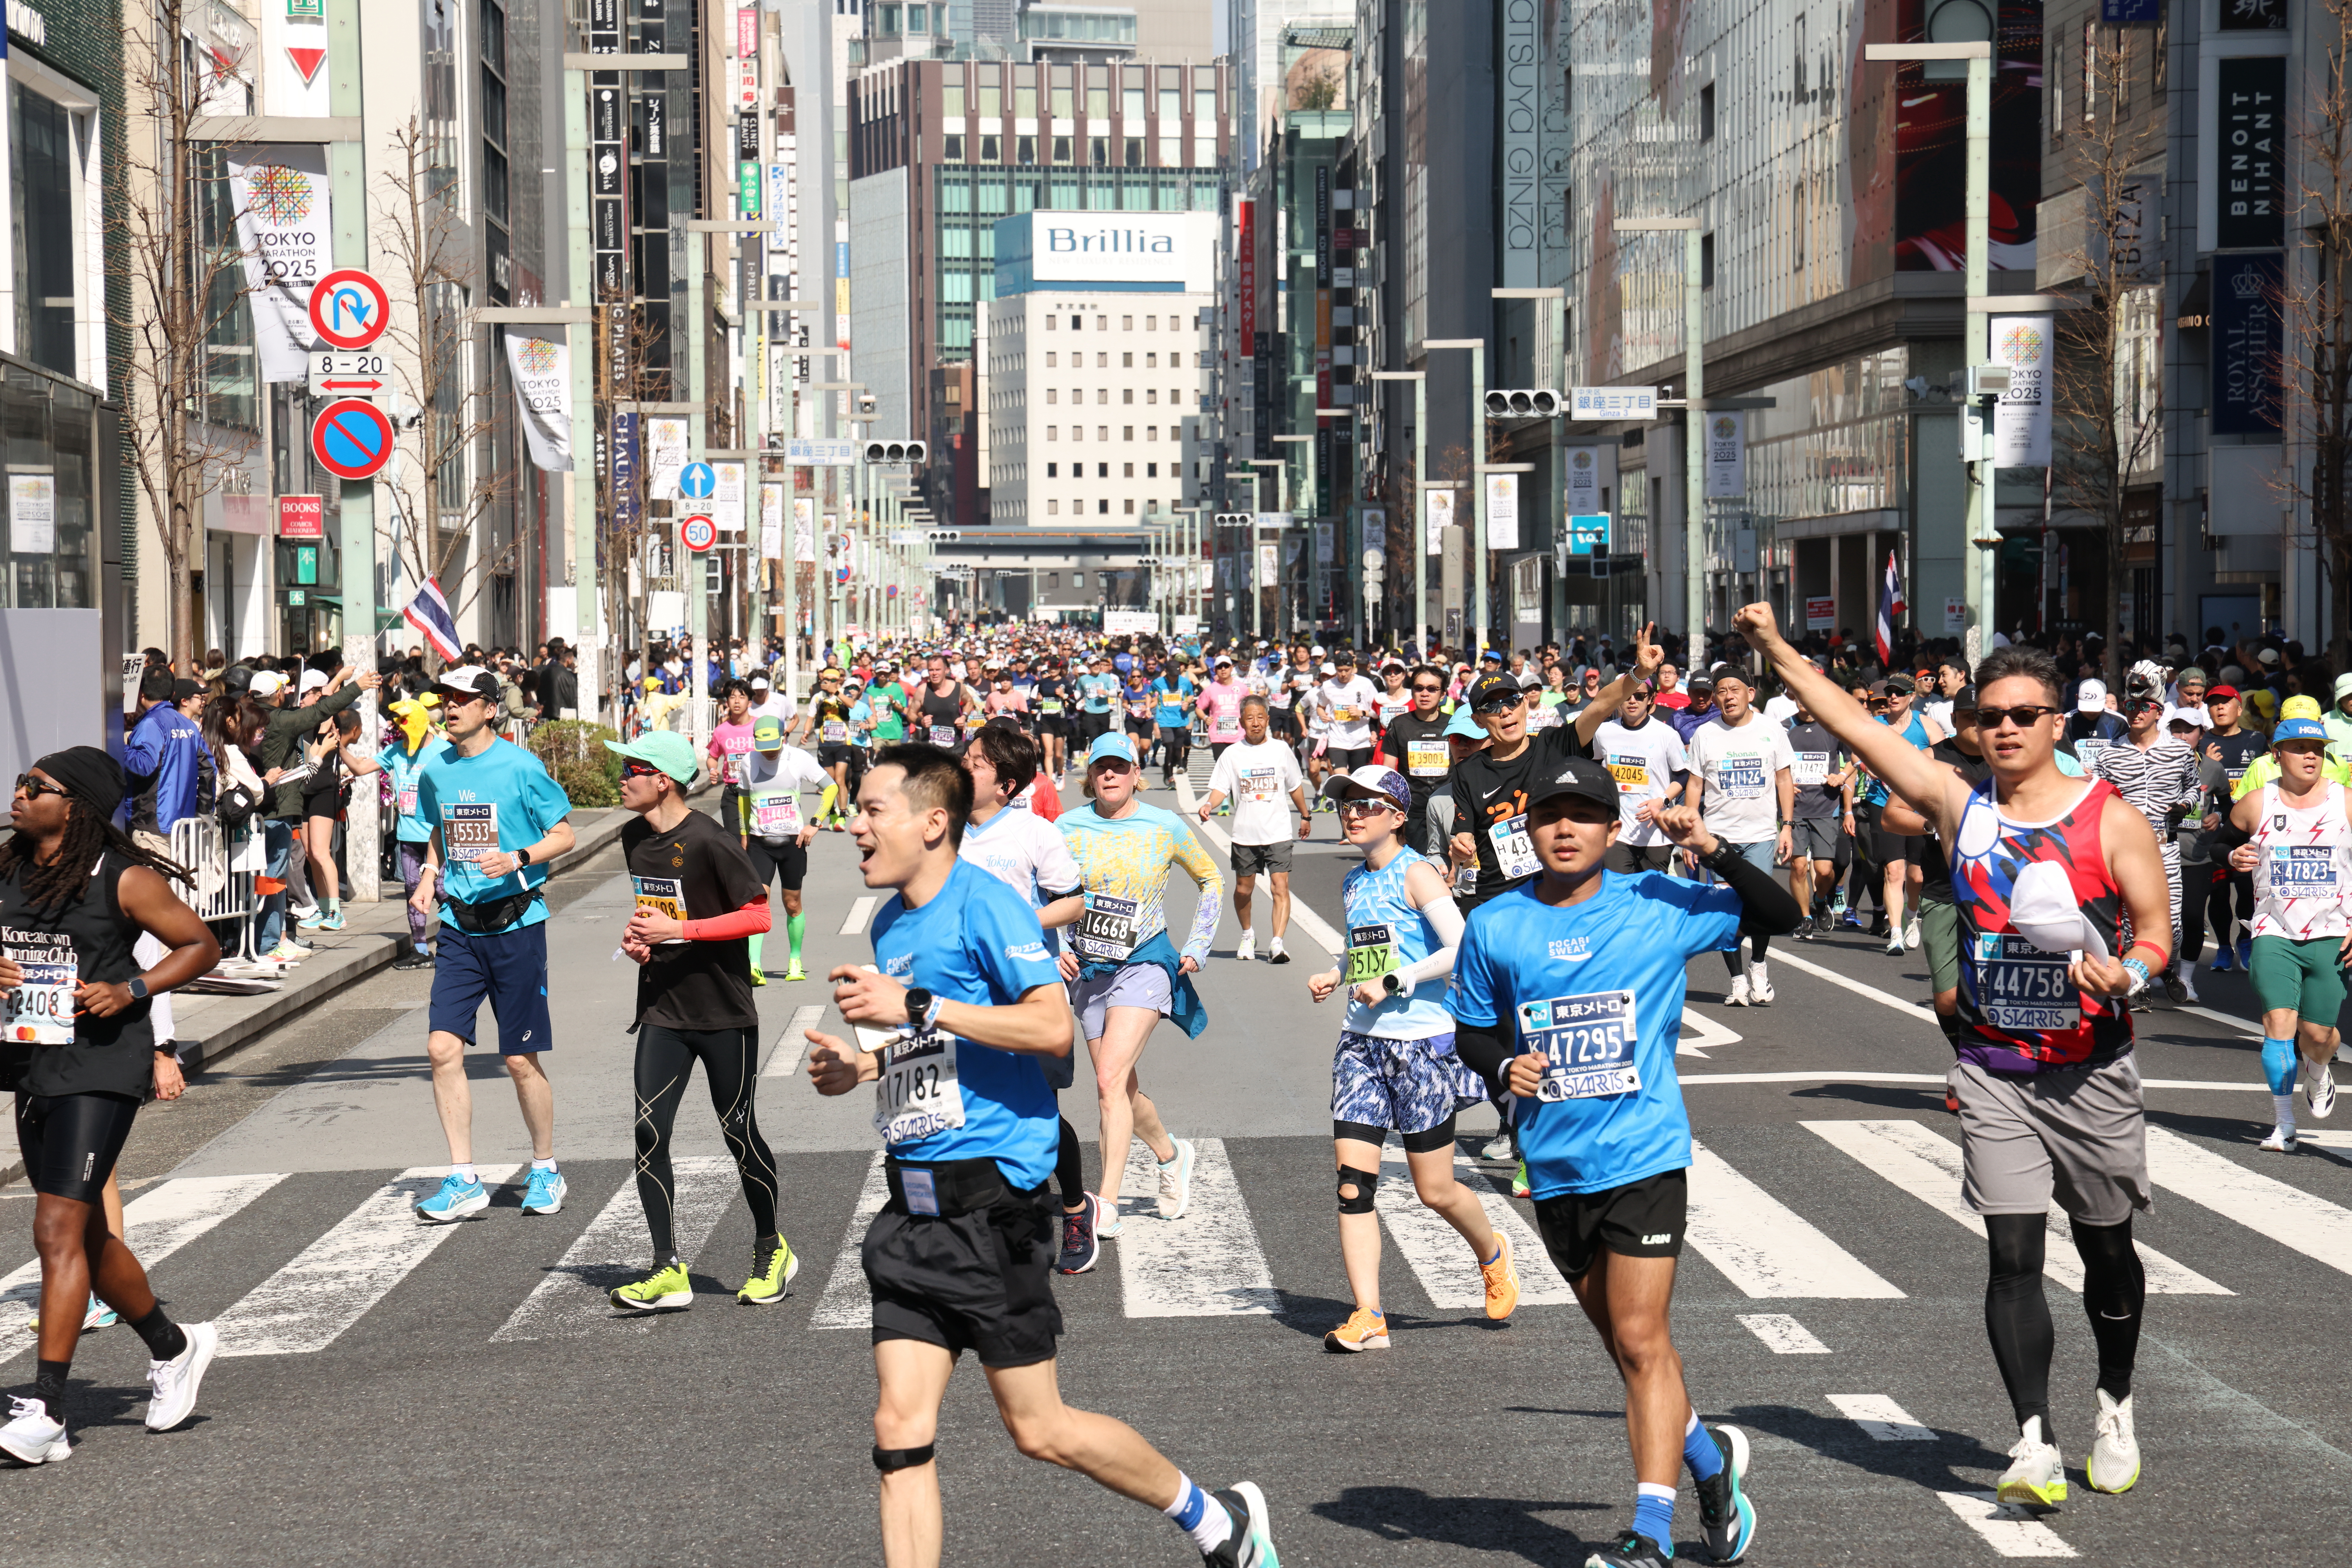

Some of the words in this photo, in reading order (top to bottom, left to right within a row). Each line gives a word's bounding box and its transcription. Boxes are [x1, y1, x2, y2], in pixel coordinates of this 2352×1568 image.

[649, 99, 660, 153] ジェーン英会話
[2231, 93, 2248, 215] BENOIT
[2254, 92, 2271, 214] NIHANT
[254, 232, 315, 246] TOKYO
[1047, 229, 1174, 253] Brillia
[259, 249, 315, 257] MARATHON
[262, 260, 316, 278] 2025
[1242, 262, 1252, 332] 銀座アスター
[2227, 321, 2246, 403] ROYAL
[2249, 305, 2267, 415] ASSCHER
[521, 379, 560, 389] TOKYO
[526, 396, 561, 408] 2025
[1578, 396, 1651, 409] 銀座三丁目
[790, 446, 850, 457] 銀座三丁目
[283, 503, 320, 513] BOOKS
[689, 526, 708, 541] 50
[1218, 694, 1238, 704] HMJ
[2299, 726, 2324, 737] HOKA
[1418, 753, 1443, 764] 39003
[1615, 767, 1642, 781] 42045
[1800, 763, 1824, 773] 17472
[1249, 779, 1274, 789] 34498
[1730, 771, 1760, 784] 41126
[458, 789, 475, 802] We
[767, 808, 792, 820] 14484
[446, 824, 450, 834] J
[454, 823, 489, 841] 45533
[1497, 844, 1506, 855] H
[986, 855, 1016, 871] Tokyo
[2274, 864, 2281, 874] K
[2285, 862, 2327, 880] 47823
[643, 882, 674, 893] 東京メトロ
[1096, 899, 1134, 913] 東京メトロ
[1085, 913, 1129, 939] 16668
[1, 926, 71, 946] Koreatown
[1076, 927, 1081, 935] 3
[1098, 935, 1116, 944] MARATHON
[1354, 930, 1386, 942] 東京メトロ
[1548, 936, 1590, 949] POCARI
[47, 946, 78, 964] Club
[1549, 944, 1586, 956] SWEAT
[1977, 968, 1987, 984] K
[1994, 966, 2064, 998] 44758
[6, 989, 59, 1016] 42408
[1980, 992, 1985, 1004] 3
[1555, 1000, 1621, 1019] 東京メトロ
[893, 1035, 938, 1058] 東京メトロ
[1528, 1039, 1541, 1054] K
[1549, 1025, 1622, 1066] 47295
[1588, 1062, 1621, 1071] MARATHON
[887, 1064, 940, 1109] 17182
[876, 1111, 885, 1123] 2
[1641, 1234, 1671, 1245] LRN
